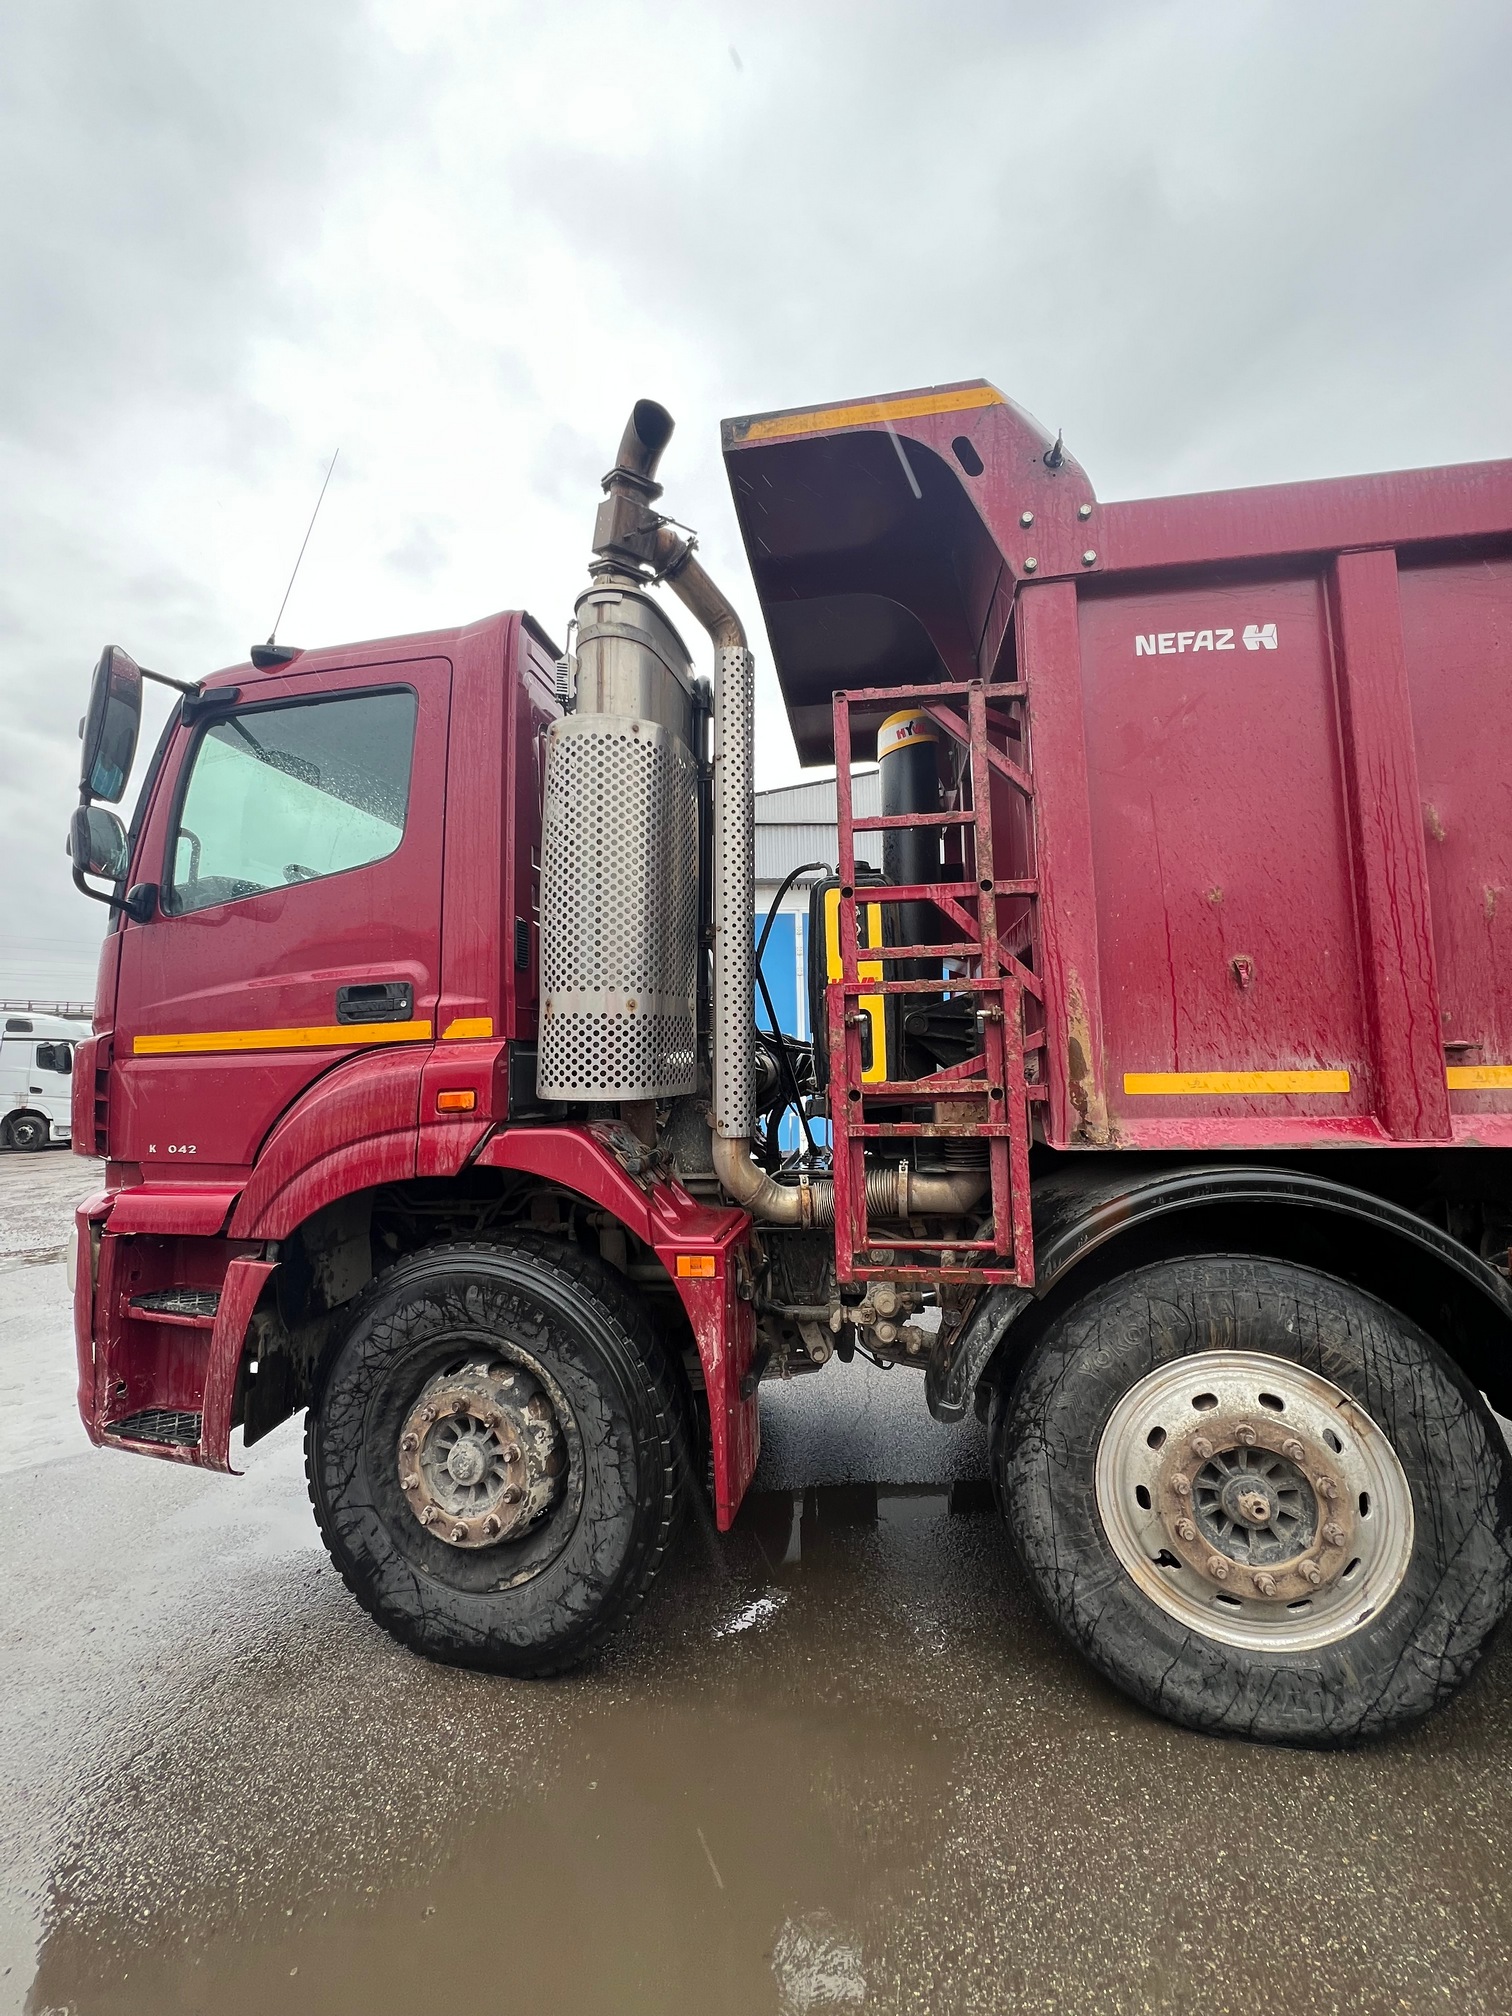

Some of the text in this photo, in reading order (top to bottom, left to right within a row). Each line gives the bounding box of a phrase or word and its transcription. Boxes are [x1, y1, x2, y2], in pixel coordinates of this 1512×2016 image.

[1135, 628, 1236, 656] NEFAZ
[148, 1144, 197, 1154] K 042
